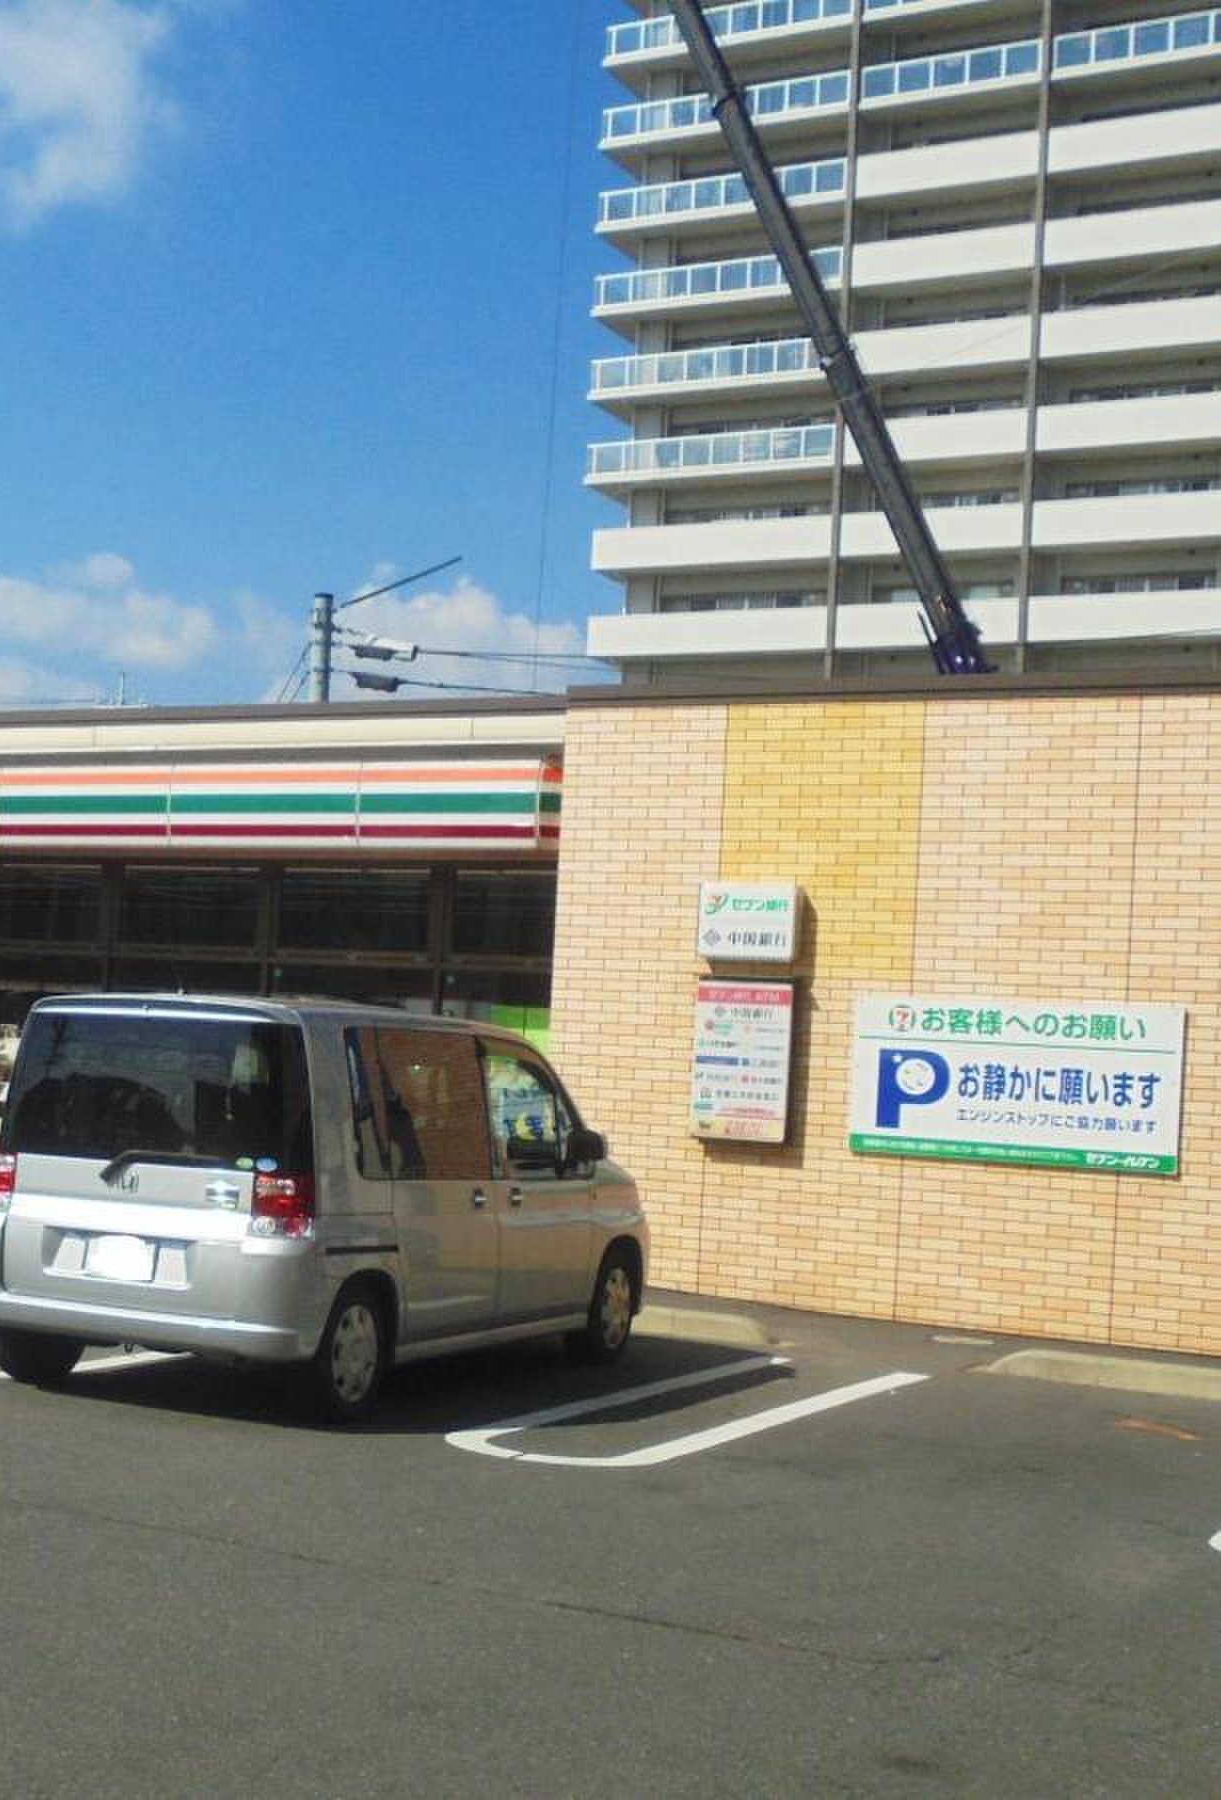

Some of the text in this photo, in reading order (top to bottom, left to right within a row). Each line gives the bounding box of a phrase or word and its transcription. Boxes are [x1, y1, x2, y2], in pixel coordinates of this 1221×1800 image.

[920, 1007, 1147, 1041] お客様へのお願い
[875, 1047, 951, 1128] P
[957, 1063, 1161, 1109] お静かに願います
